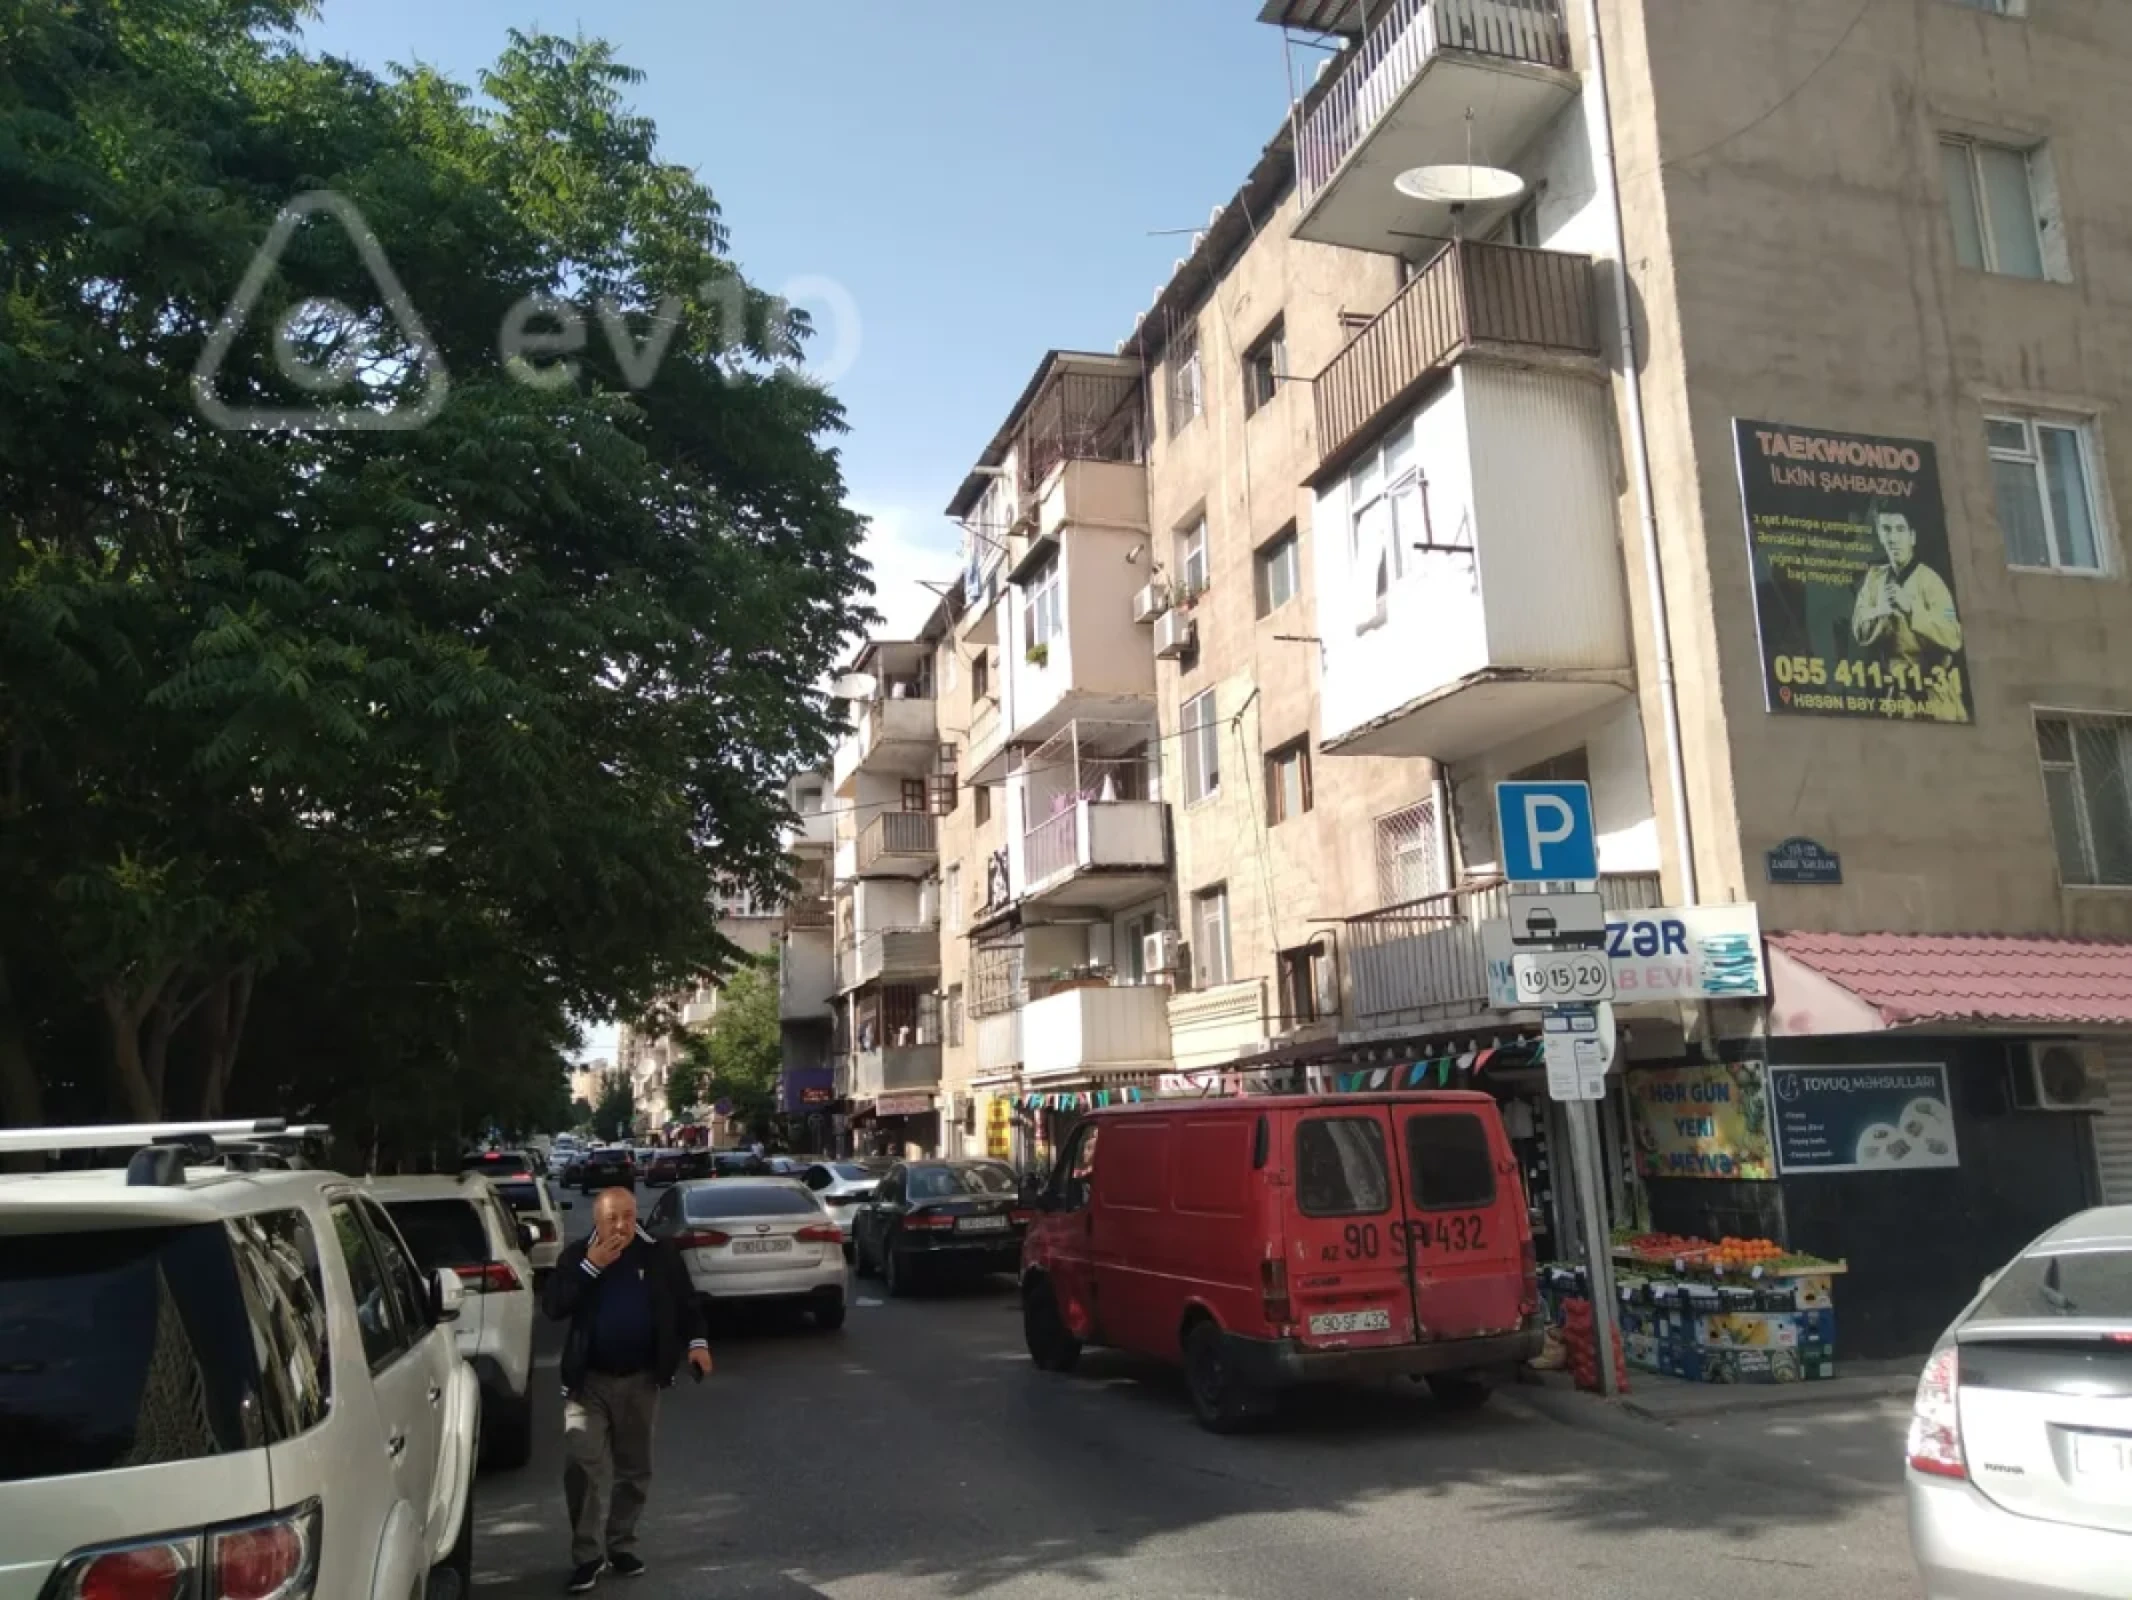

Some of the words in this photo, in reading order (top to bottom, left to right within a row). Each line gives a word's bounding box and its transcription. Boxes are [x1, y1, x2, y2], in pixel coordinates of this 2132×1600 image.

[1756, 431, 1921, 473] TAEKWONDO
[1771, 463, 1815, 487] İLKİN
[1820, 471, 1913, 497] ŞAHBAZOV
[1774, 655, 1827, 685] 055
[1835, 659, 1962, 697] 411-11-31
[1793, 693, 1844, 710] HƏSƏN
[1847, 697, 1875, 712] BƏY
[1523, 793, 1575, 871] P
[1580, 919, 1689, 957] ZƏR
[1525, 970, 1543, 987] 10
[1550, 967, 1570, 987] 15
[1577, 965, 1602, 985] 20
[1645, 957, 1694, 989] EVİ
[1344, 1223, 1379, 1259] 90
[1435, 1213, 1487, 1253] 432
